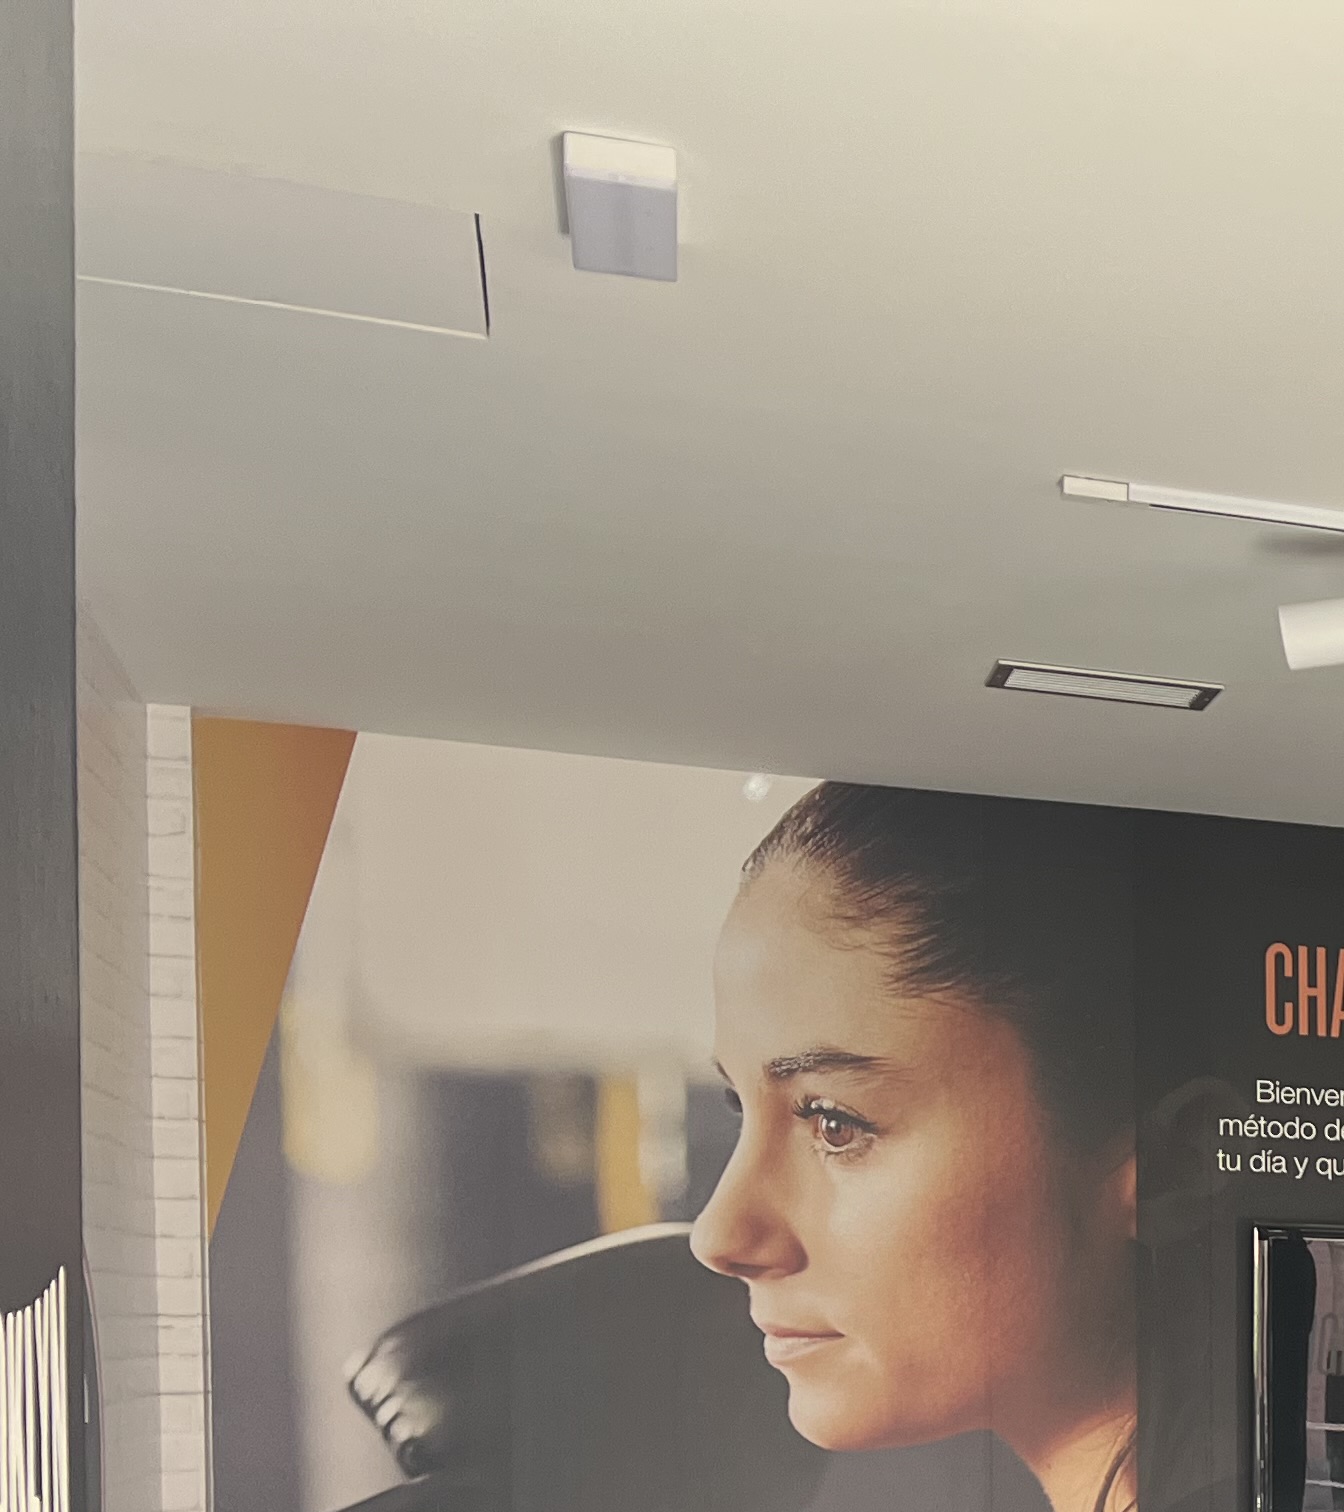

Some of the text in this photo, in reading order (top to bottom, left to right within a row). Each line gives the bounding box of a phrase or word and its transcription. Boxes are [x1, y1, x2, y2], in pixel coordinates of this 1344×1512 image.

[1219, 1114, 1316, 1139] método
[1217, 1149, 1240, 1171] tu
[1250, 1150, 1287, 1173] día
[1294, 1157, 1308, 1179] y
